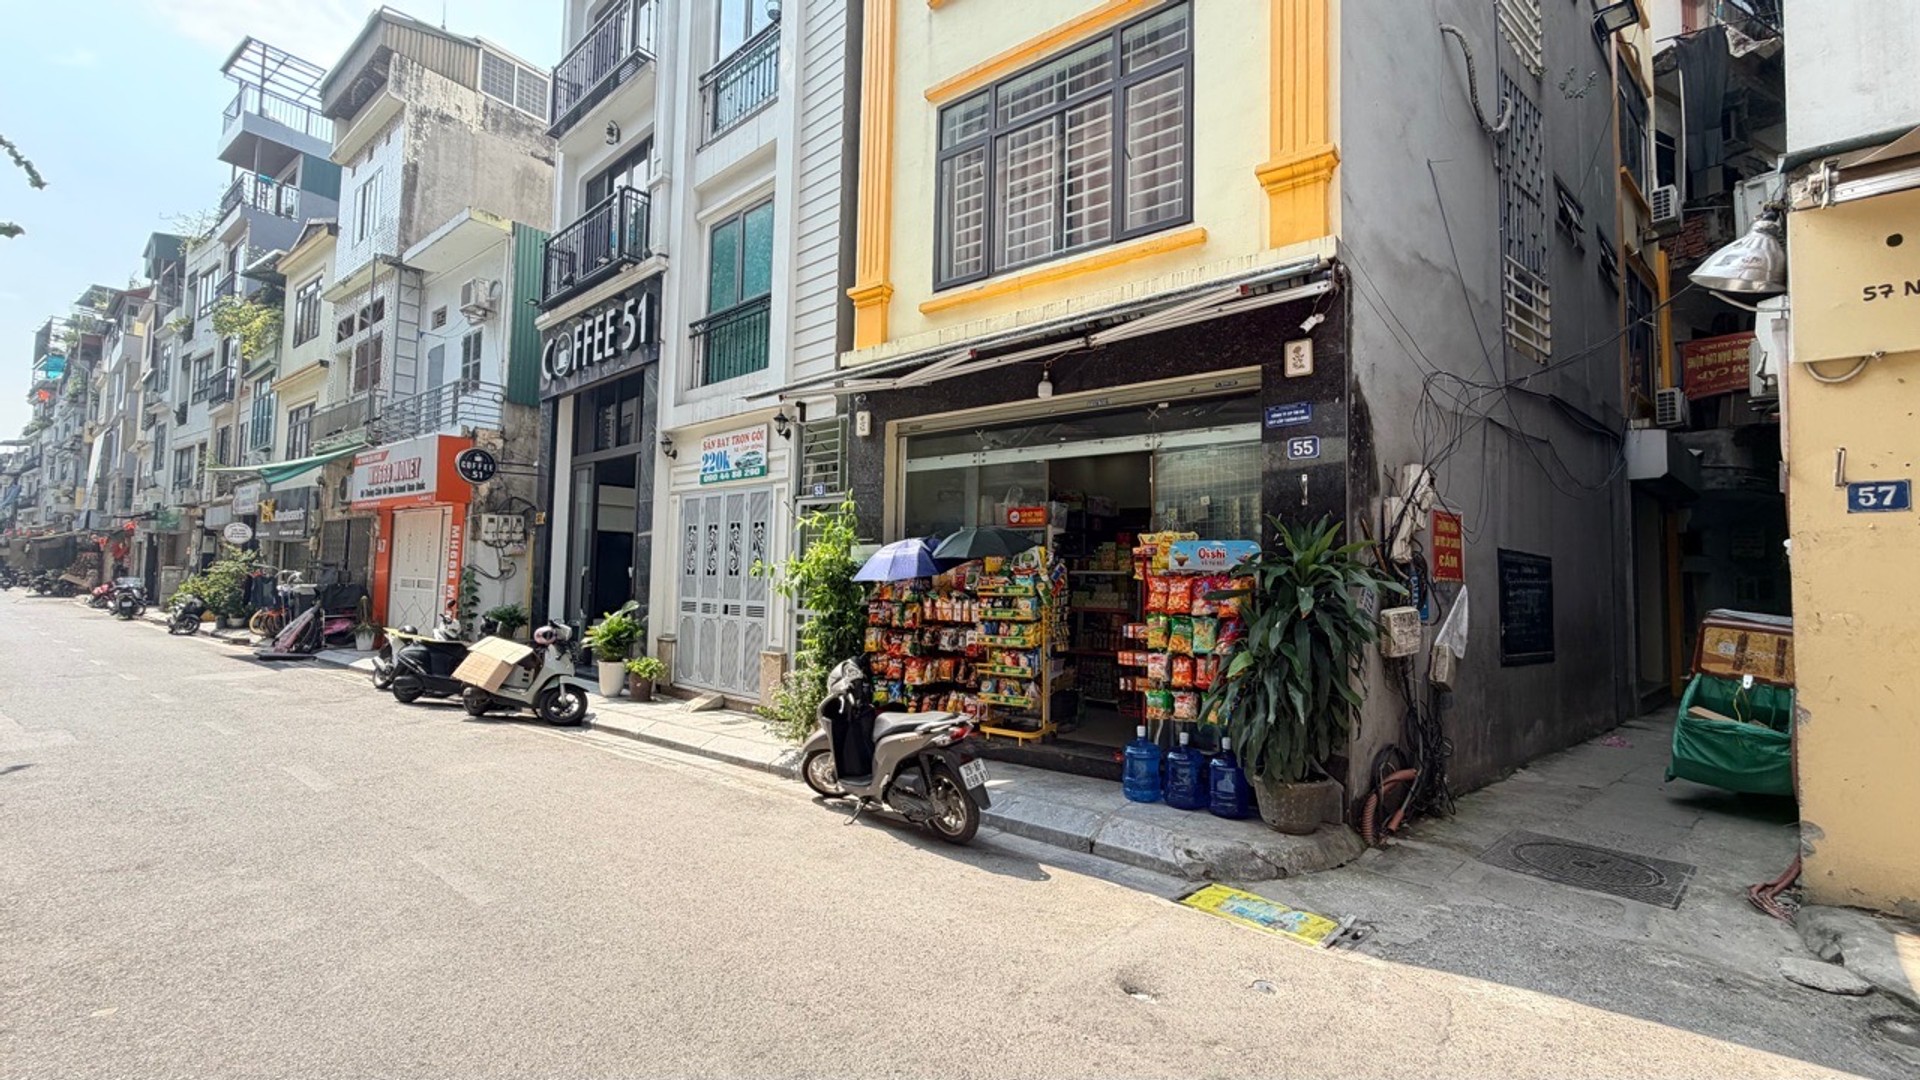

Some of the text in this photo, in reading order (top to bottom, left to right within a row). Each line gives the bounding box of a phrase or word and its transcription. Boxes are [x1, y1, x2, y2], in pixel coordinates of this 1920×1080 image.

[1863, 284, 1895, 301] 57
[541, 291, 649, 380] COFFEE 51
[717, 437, 729, 448] BAY
[731, 433, 750, 446] TRỌN
[1293, 440, 1313, 456] 55
[394, 457, 421, 481] MONEY
[461, 460, 494, 479] COFFEE 51
[1858, 485, 1897, 507] 57
[1198, 547, 1226, 560] Oishi
